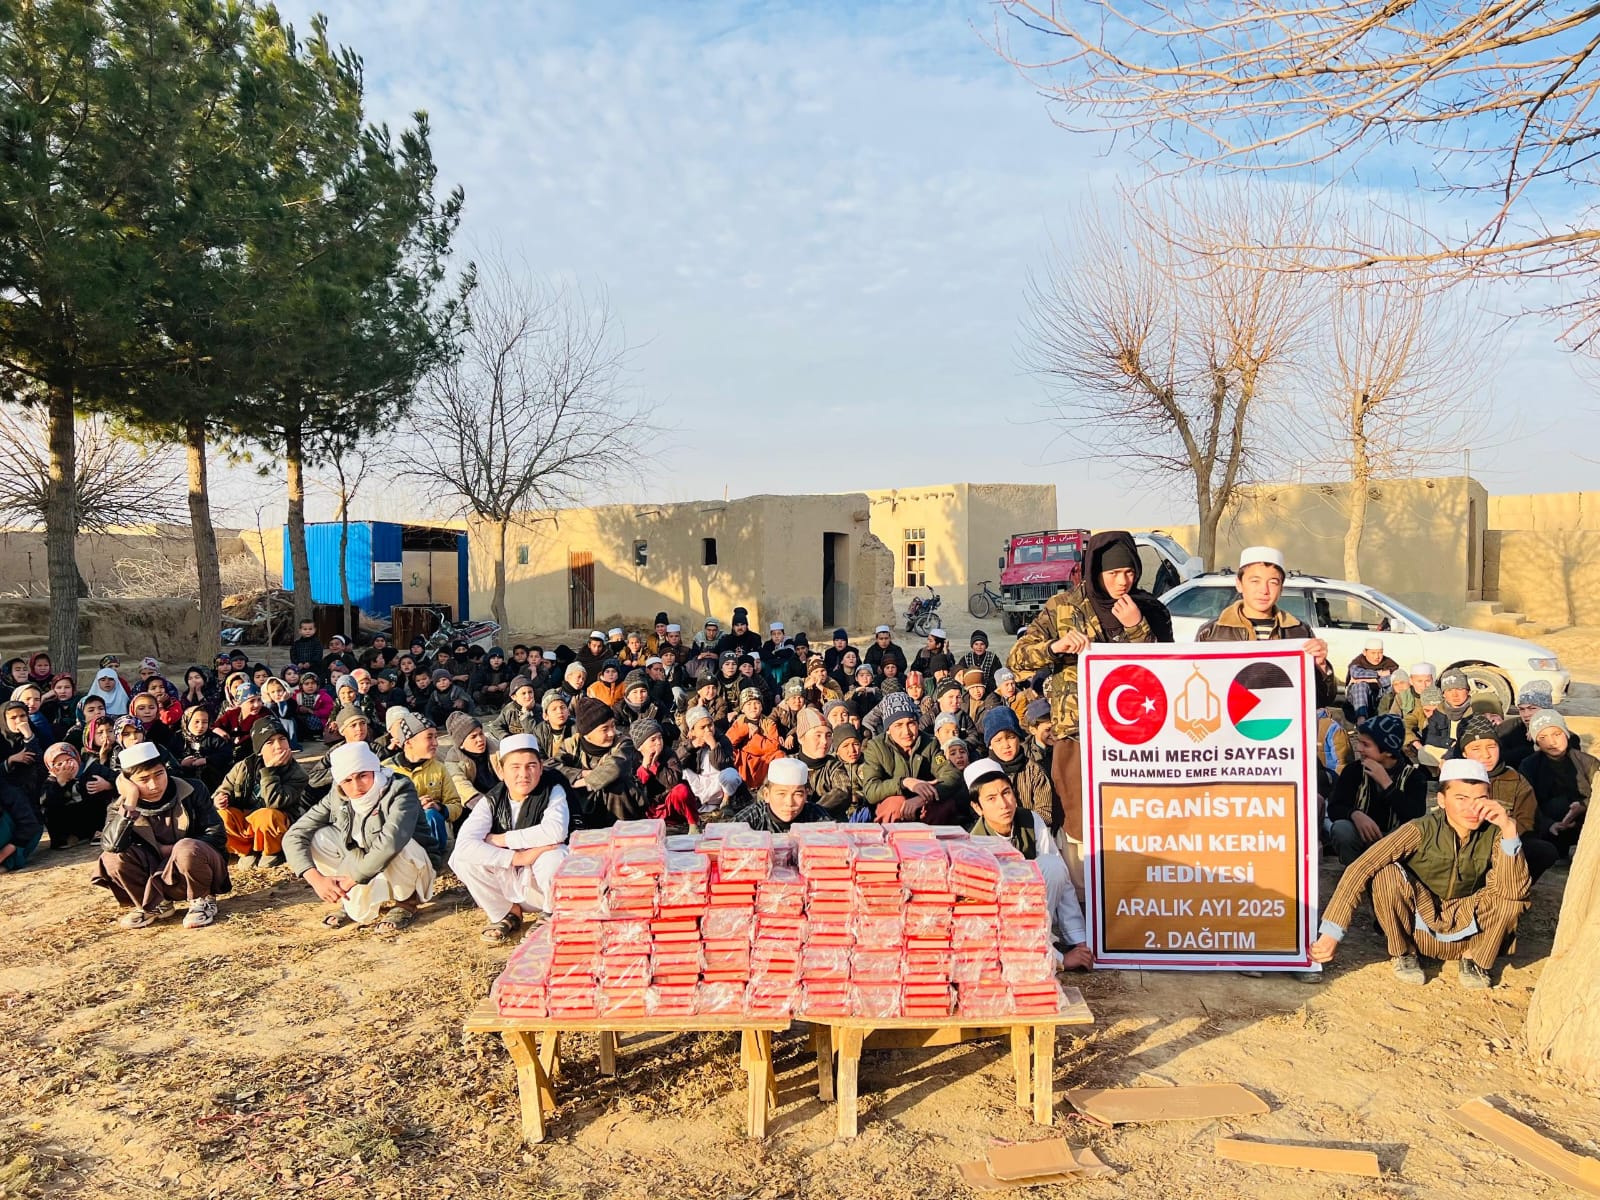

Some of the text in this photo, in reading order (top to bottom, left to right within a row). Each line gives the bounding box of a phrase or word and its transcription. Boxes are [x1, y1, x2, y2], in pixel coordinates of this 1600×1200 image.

[1102, 745, 1295, 762] İSLAMİ MERCİ SAYFASI
[1110, 767, 1282, 778] MUHAMMED EMRE KARADAYI
[1111, 792, 1284, 818] AFGANİSTAN
[1115, 830, 1285, 853] KURANI KERİM
[1146, 862, 1254, 883] HEDİYESİ
[1116, 898, 1285, 917] ARALIK AYI 2025
[1144, 928, 1256, 949] 2. DAĞITIM
